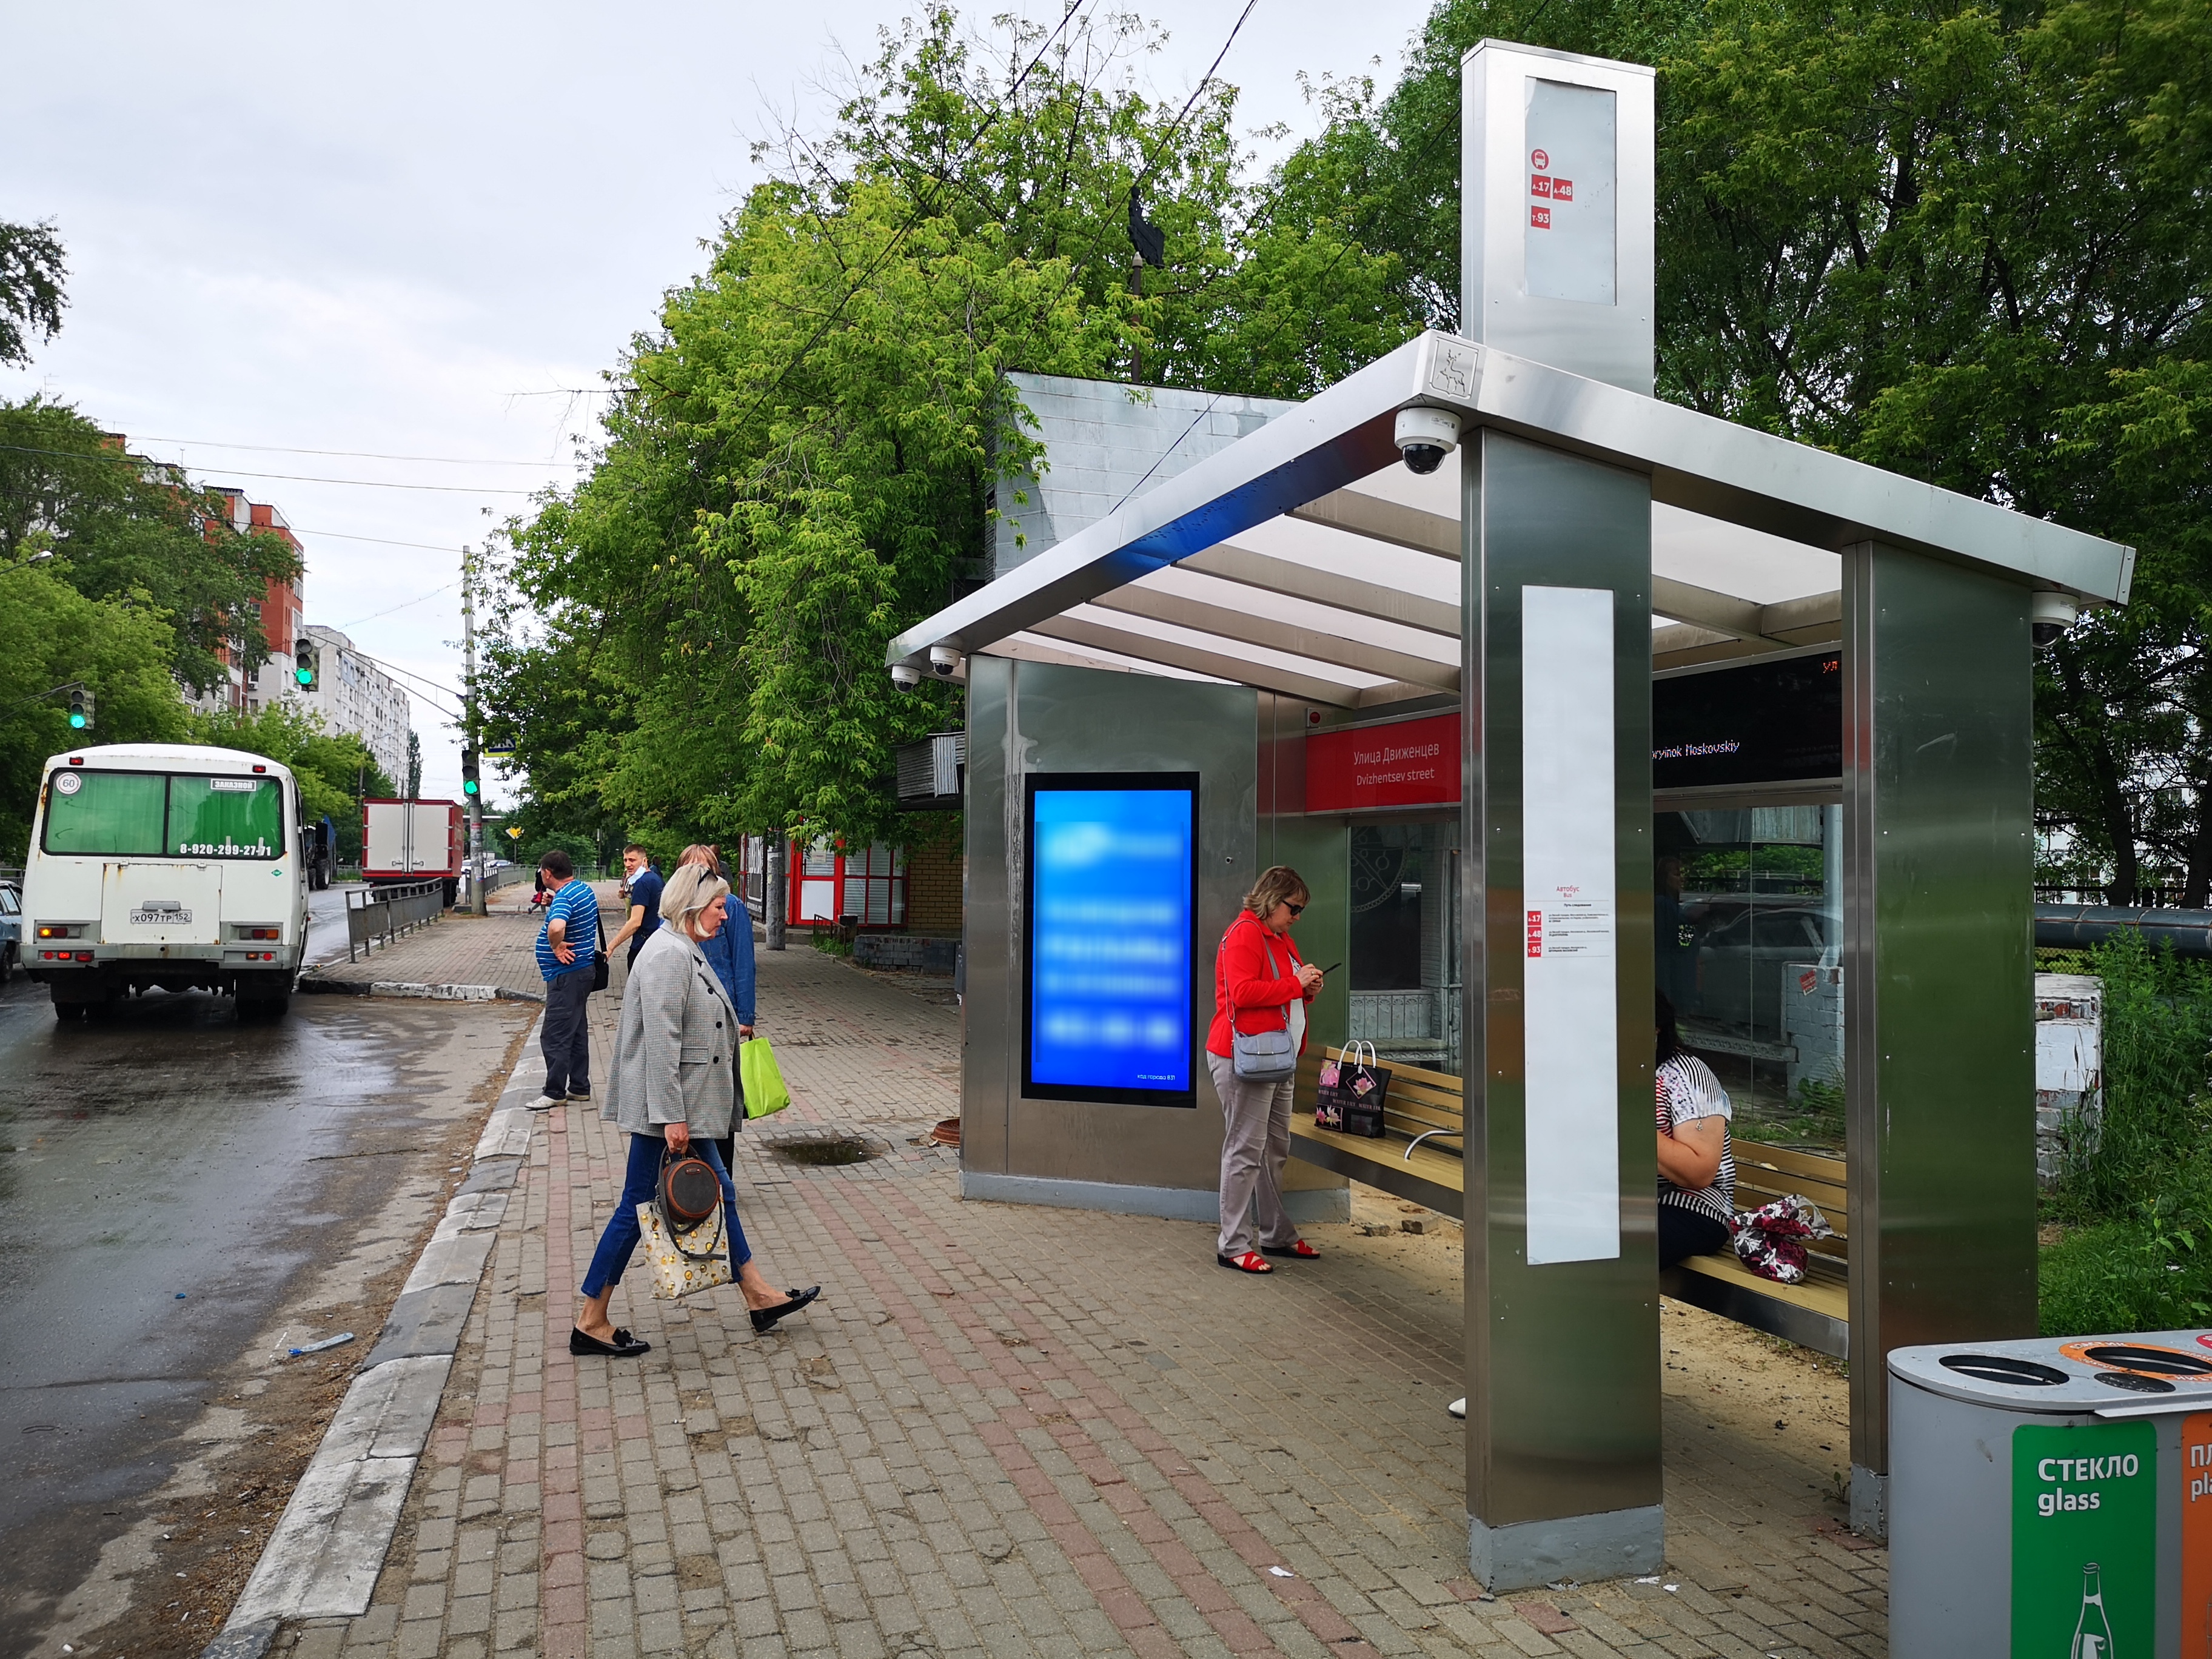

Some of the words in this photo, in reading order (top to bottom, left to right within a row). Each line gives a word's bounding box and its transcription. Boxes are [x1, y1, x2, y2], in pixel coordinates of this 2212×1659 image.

[1353, 751, 1381, 765] Улица
[1382, 743, 1439, 765] Движенцев
[1686, 739, 1740, 756] Moskovskiy
[62, 779, 75, 788] 60
[1356, 773, 1406, 786] Dvizhentsev
[1407, 768, 1435, 781] street
[180, 843, 271, 856] 8-920-299-27-71
[2037, 1454, 2139, 1481] СТЕКЛО
[2038, 1487, 2100, 1517] glass
